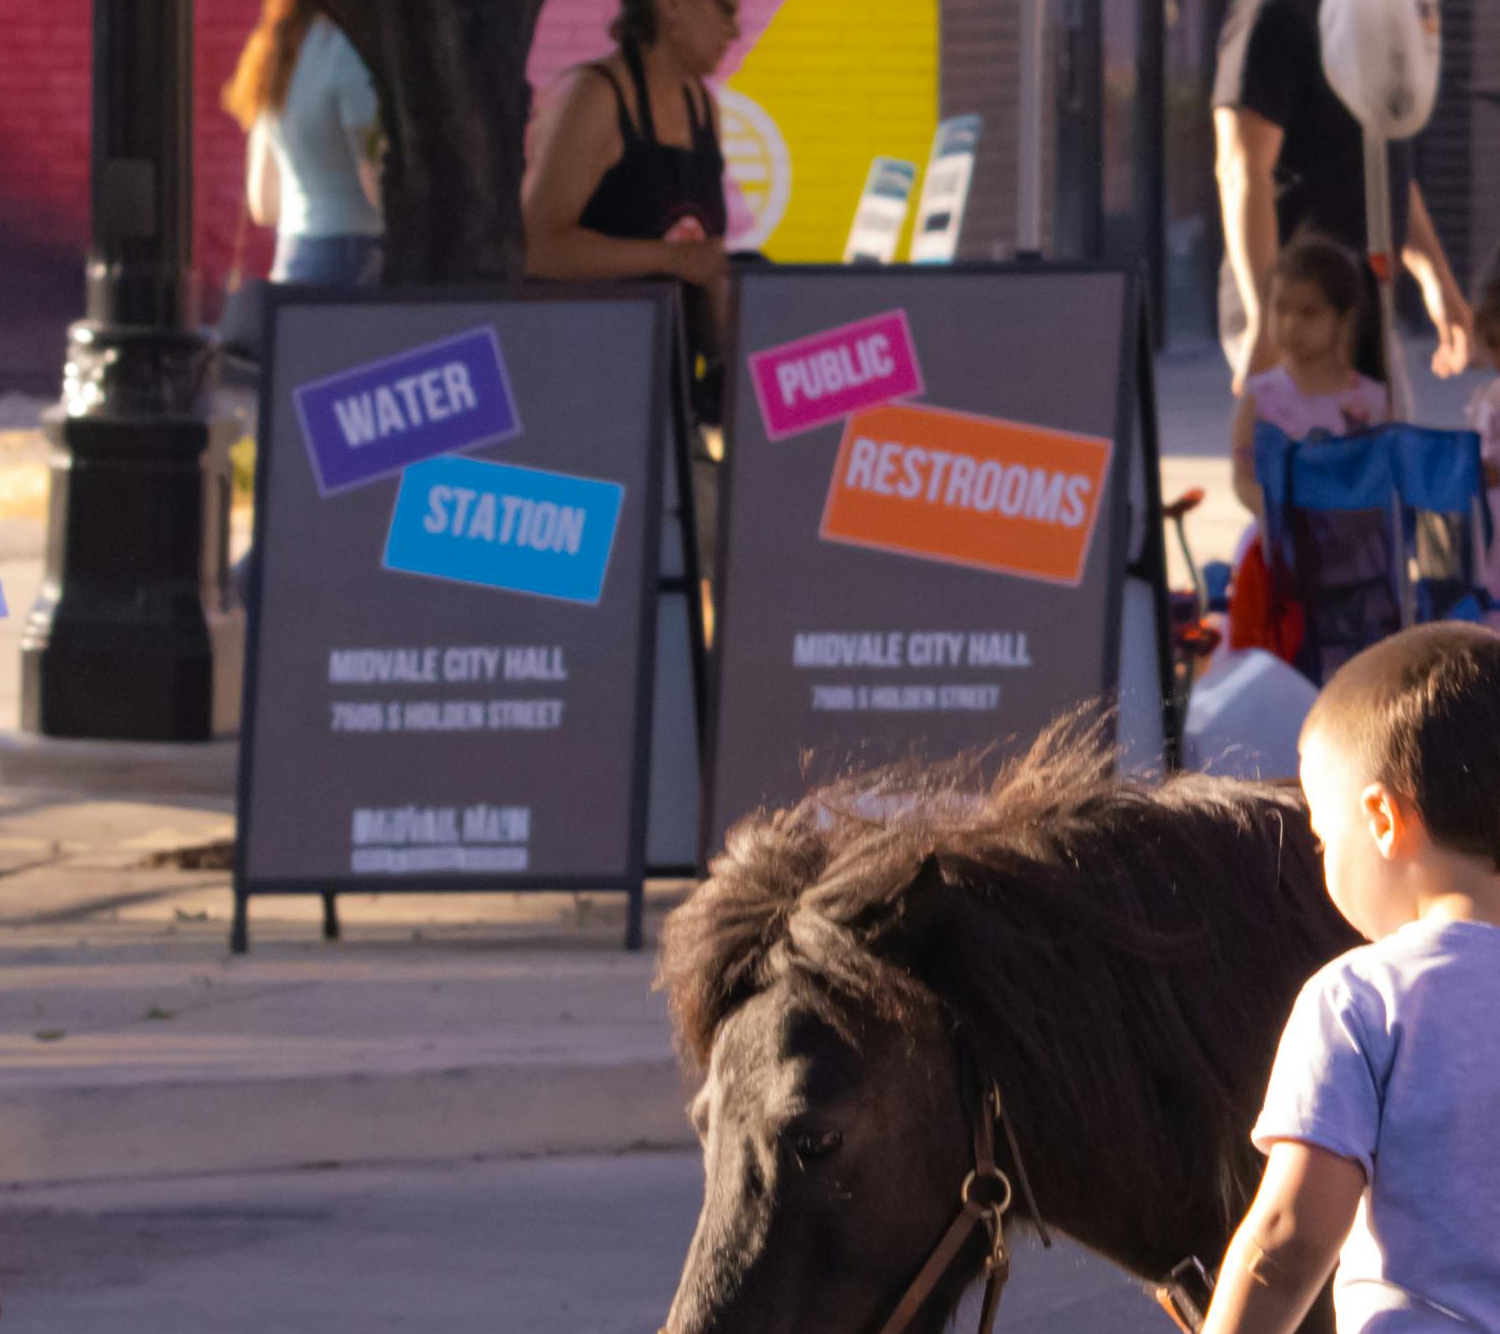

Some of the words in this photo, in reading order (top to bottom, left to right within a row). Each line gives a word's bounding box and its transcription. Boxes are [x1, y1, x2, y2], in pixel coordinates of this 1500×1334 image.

[334, 360, 477, 447] WATER
[775, 334, 895, 406] PUBLIC
[846, 437, 1092, 527] RESTROOMS
[423, 484, 587, 555] STATION
[328, 646, 438, 683] MIDVALE
[443, 646, 500, 682] CITY
[503, 645, 568, 681] HALL
[793, 631, 903, 668] MIDVALE
[907, 631, 964, 667] CITY
[967, 630, 1032, 667] HALL
